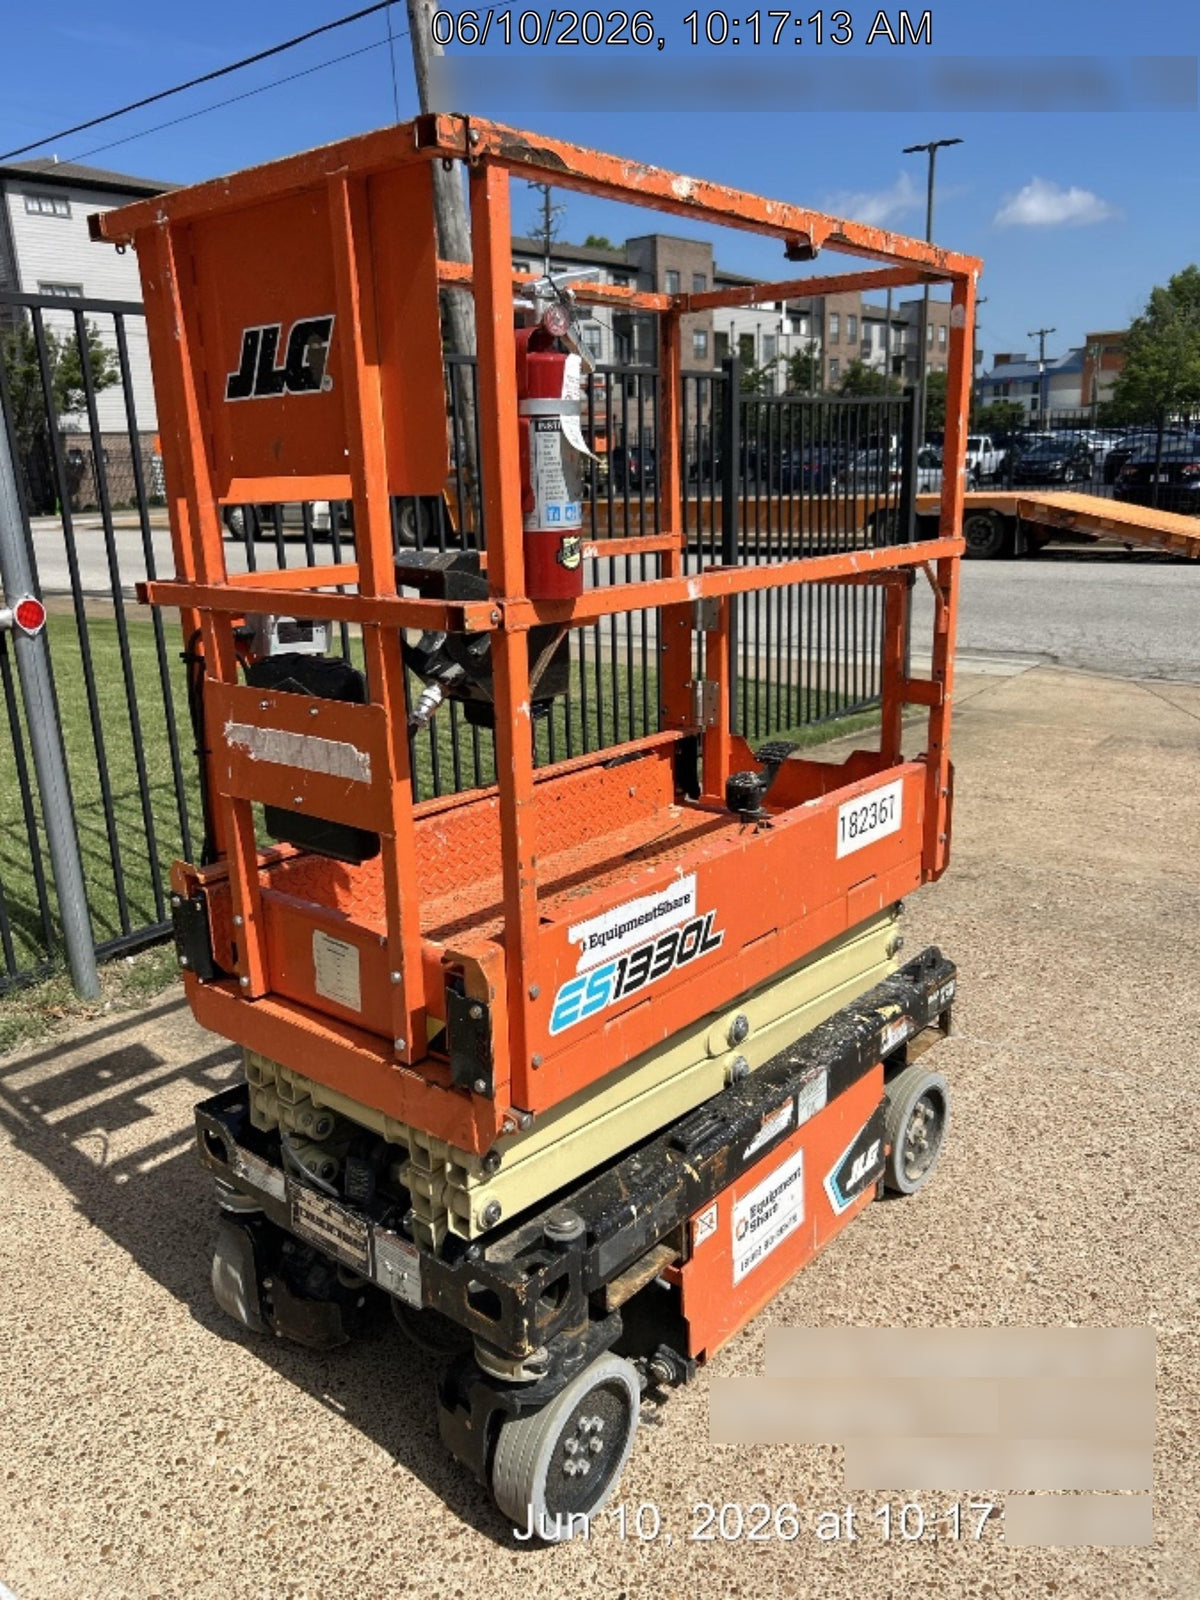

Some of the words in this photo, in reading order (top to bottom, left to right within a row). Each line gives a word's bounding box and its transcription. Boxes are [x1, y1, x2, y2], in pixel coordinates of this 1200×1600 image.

[224, 315, 336, 402] JLG
[588, 893, 691, 950] EquipmentShare
[550, 911, 724, 1034] ES1330L
[749, 1167, 802, 1217] Equipment
[845, 1138, 880, 1191] JLG
